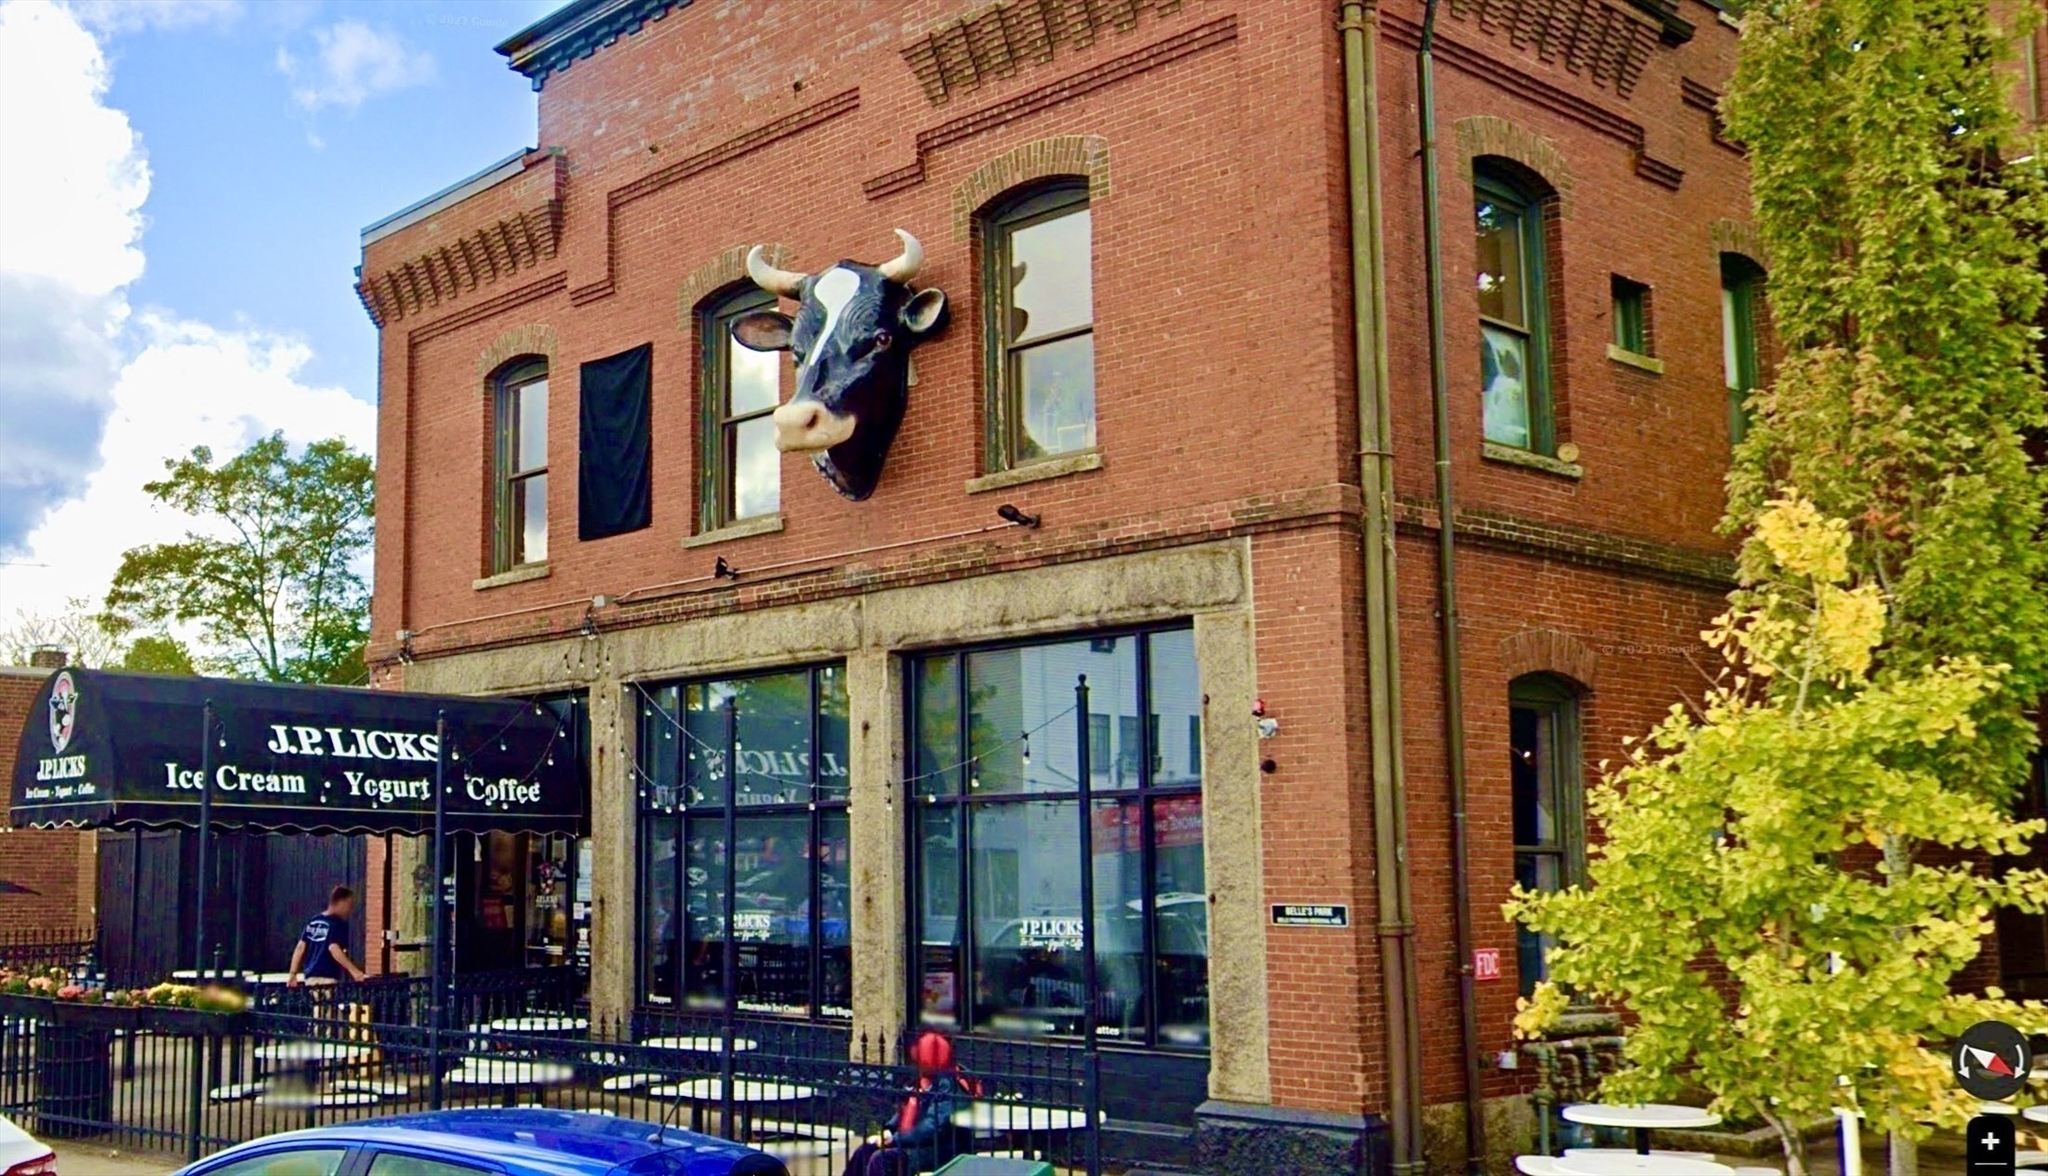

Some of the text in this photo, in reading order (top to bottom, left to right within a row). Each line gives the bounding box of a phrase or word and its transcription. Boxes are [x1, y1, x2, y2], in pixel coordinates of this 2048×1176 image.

[165, 762, 541, 804] Ice Cream Yogurt Coffee
[1313, 907, 1333, 917] PARK
[1476, 952, 1499, 976] FDC
[836, 1006, 853, 1018] Yogu
[1096, 1026, 1120, 1036] attes
